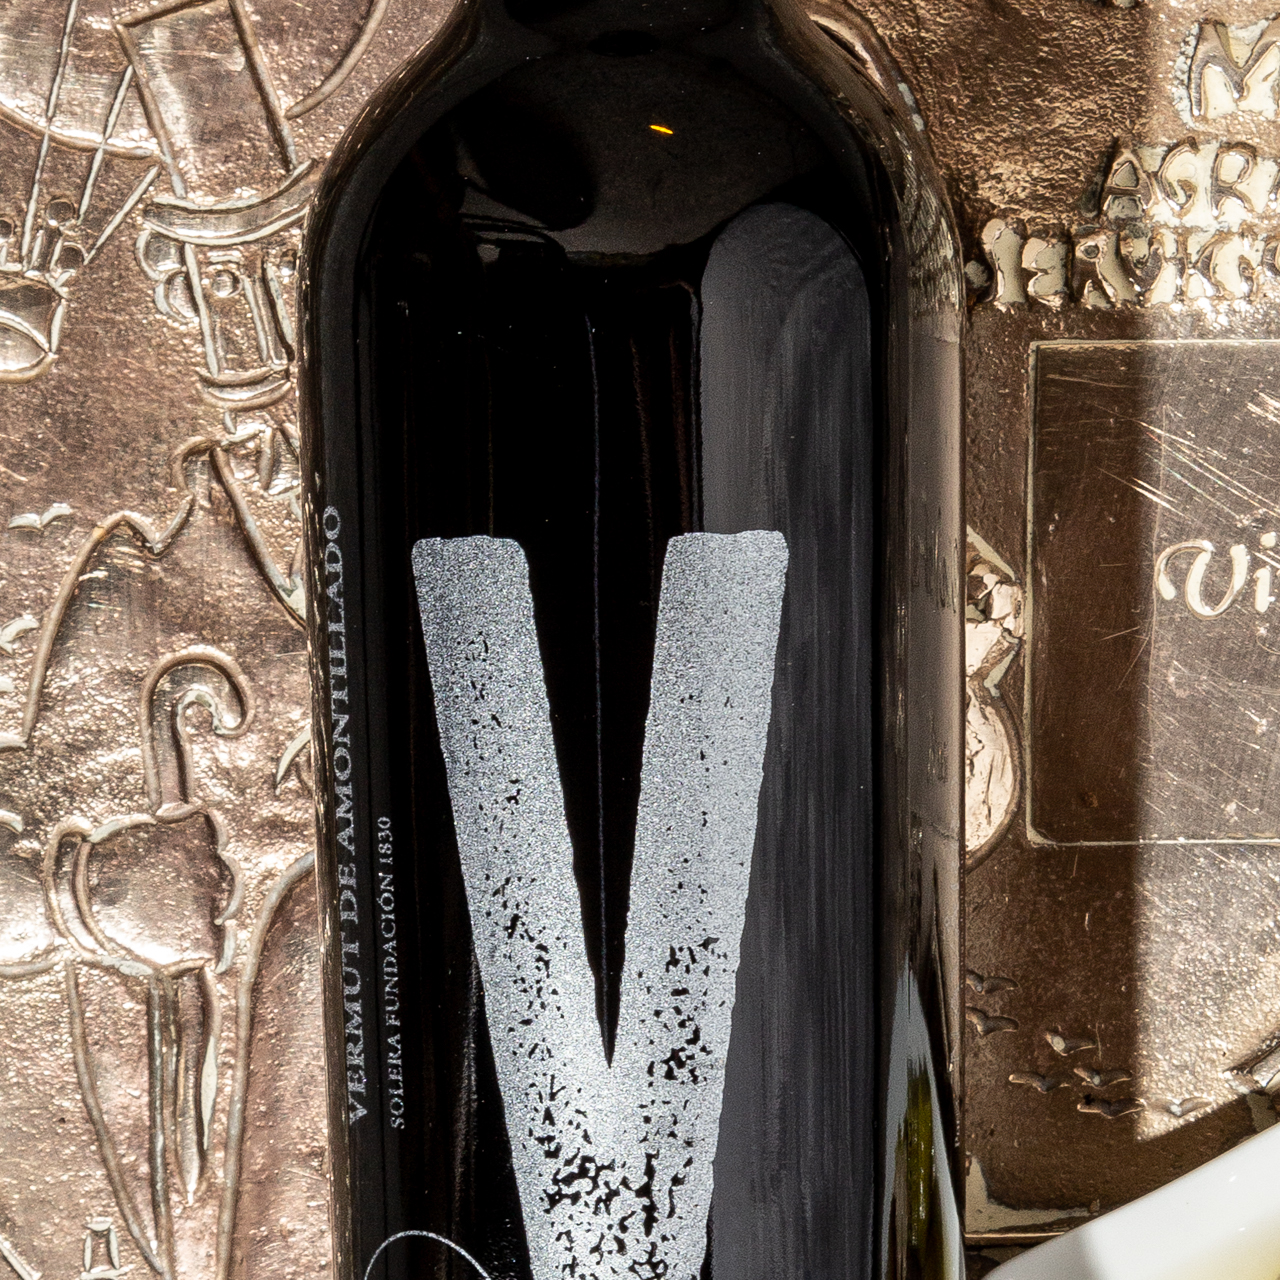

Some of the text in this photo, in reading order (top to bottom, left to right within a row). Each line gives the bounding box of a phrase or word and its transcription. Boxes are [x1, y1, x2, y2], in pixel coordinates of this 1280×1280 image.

[323, 505, 367, 1125] VERMUT DE AMONTILLADO
[376, 816, 405, 1130] SOLERA FUNDACIÓN 1830
